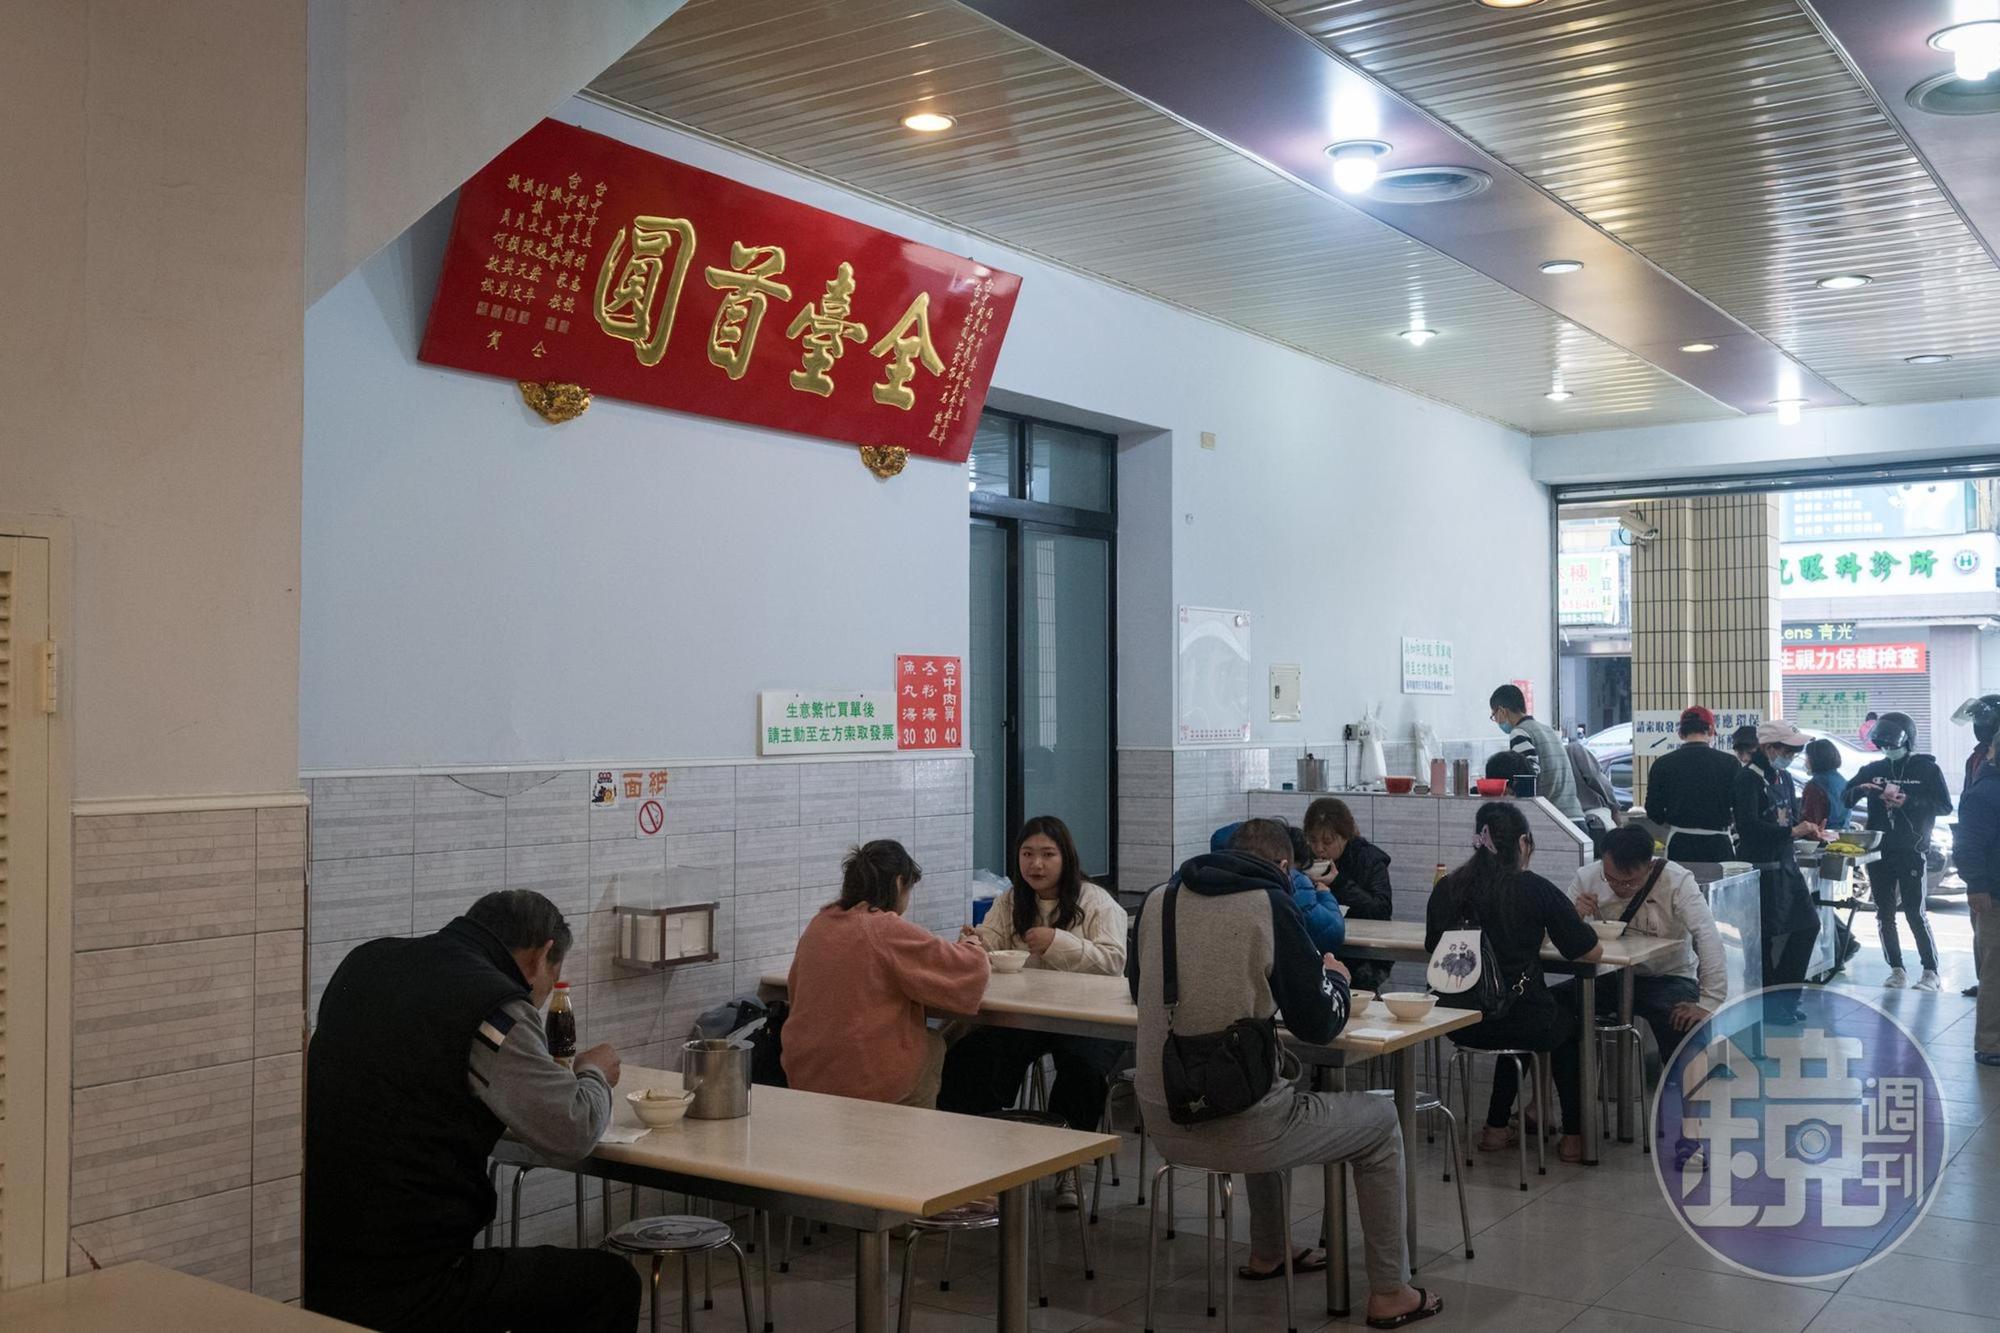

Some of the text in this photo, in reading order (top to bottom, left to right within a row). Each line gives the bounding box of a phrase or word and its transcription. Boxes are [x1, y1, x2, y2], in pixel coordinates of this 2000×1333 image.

[1818, 623, 1853, 641] 青光
[786, 701, 875, 719] 生意繁忙買單後
[902, 660, 918, 744] 魚丸湯 30
[922, 661, 938, 744] 冬粉湯 30
[768, 724, 894, 744] 請主動至左方索取發票
[944, 727, 957, 743] 40
[1636, 720, 1681, 733] 請索取發
[622, 771, 668, 798] 面紙
